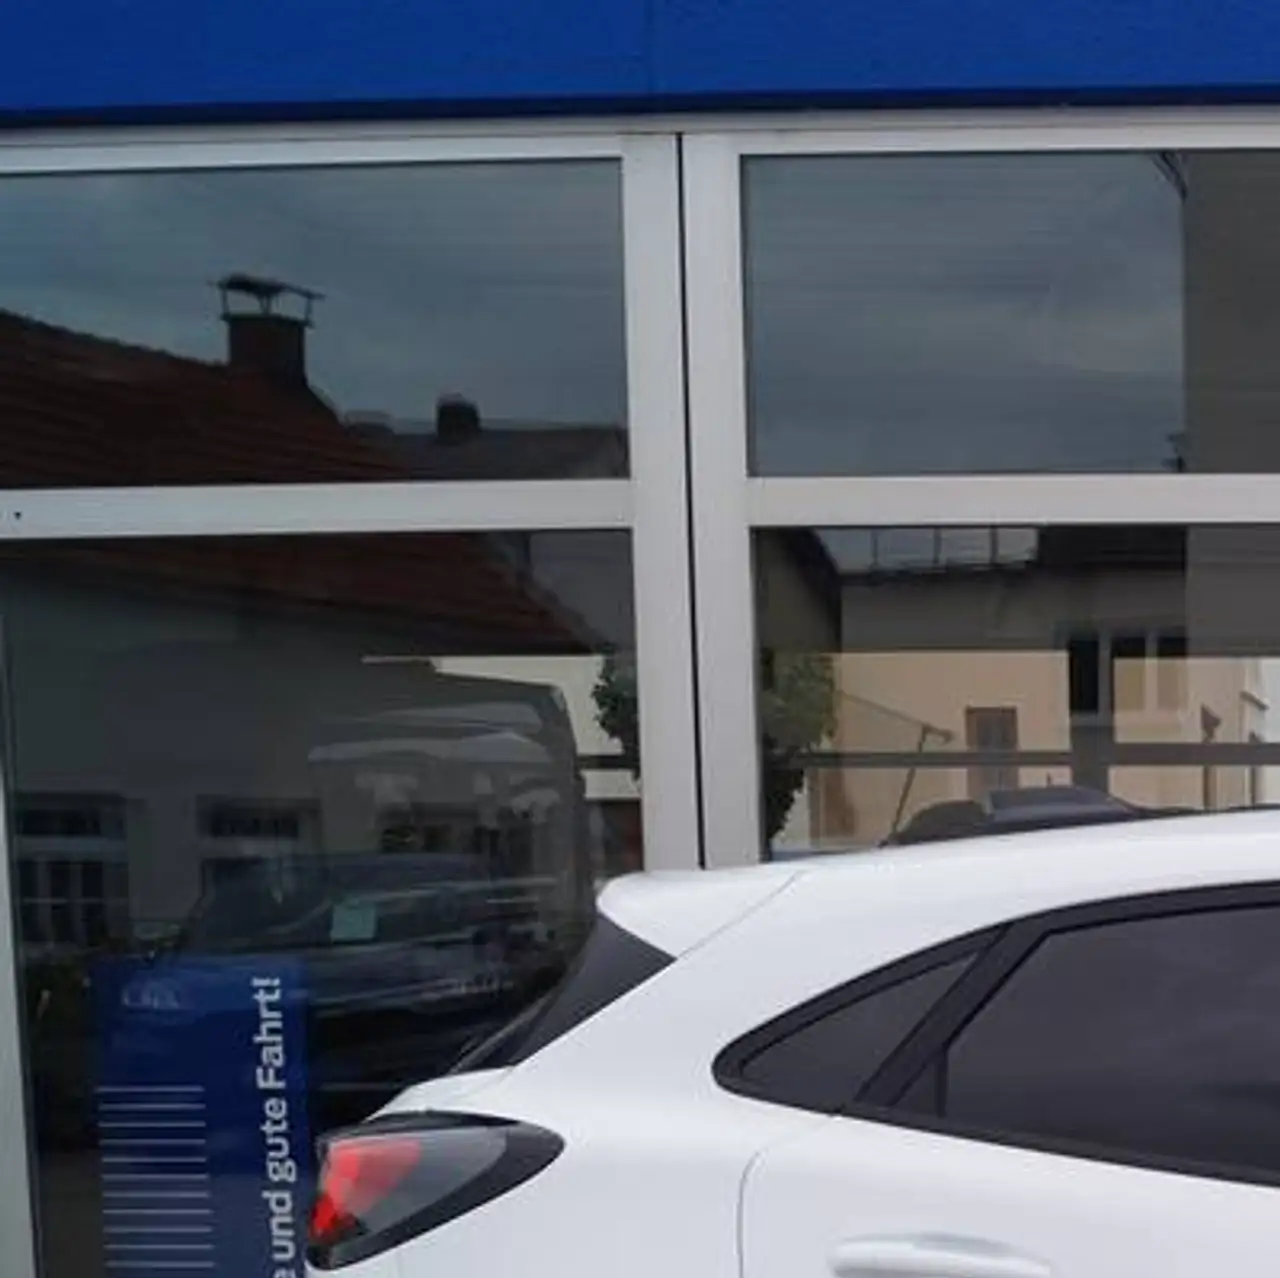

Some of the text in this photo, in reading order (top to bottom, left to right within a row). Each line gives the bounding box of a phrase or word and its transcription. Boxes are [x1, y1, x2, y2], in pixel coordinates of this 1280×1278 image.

[251, 976, 287, 1089] Fahrt!
[260, 1097, 297, 1183] gute
[261, 1190, 297, 1261] und
